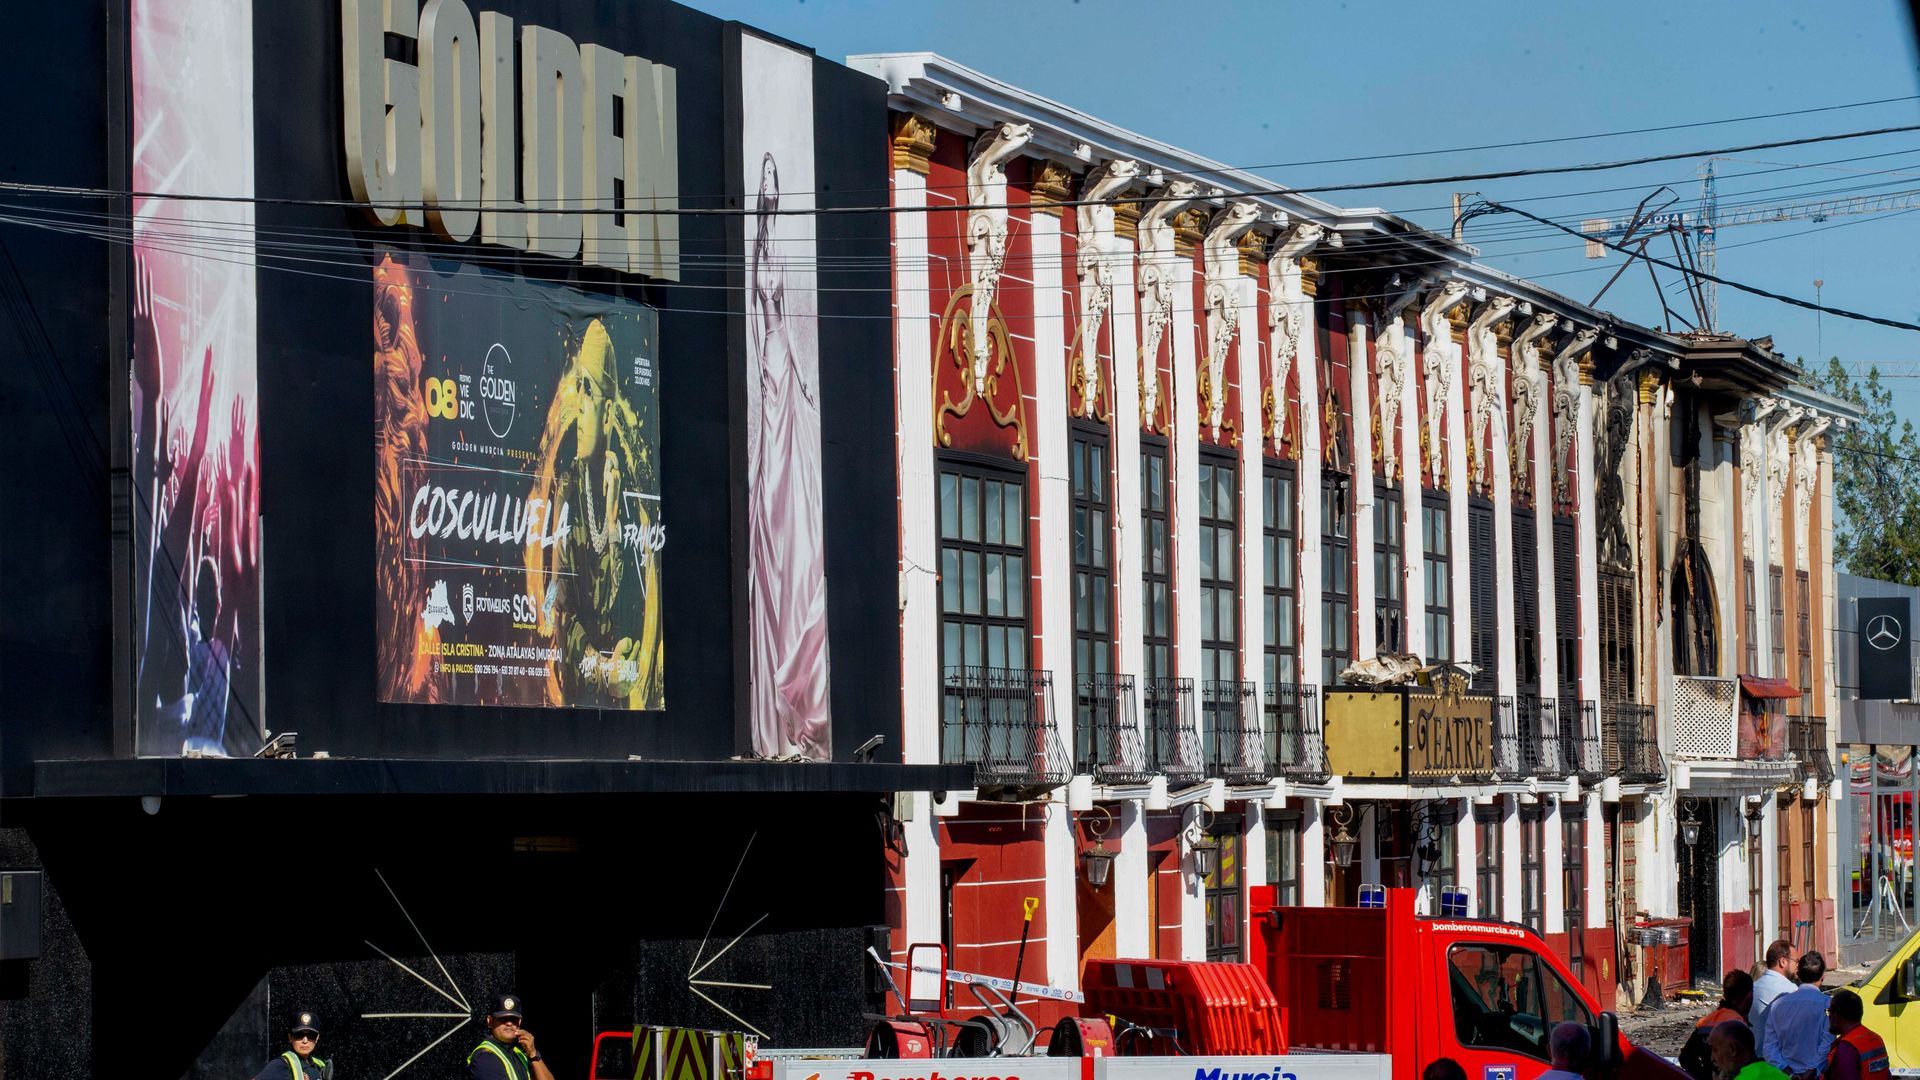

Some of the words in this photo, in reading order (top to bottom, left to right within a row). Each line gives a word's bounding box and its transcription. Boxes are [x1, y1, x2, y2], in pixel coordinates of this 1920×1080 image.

[342, 0, 680, 282] GOLDEN
[425, 377, 459, 420] 08
[460, 385, 470, 398] VIE
[480, 376, 515, 402] GOLDEN
[460, 400, 475, 420] DIC
[452, 441, 477, 453] GOLDEN
[480, 445, 504, 456] MURCIA
[410, 479, 571, 551] COSCULLUELA
[623, 522, 666, 552] FRANCIS
[513, 594, 537, 623] SCS
[420, 641, 440, 655] CALLE
[441, 643, 455, 656] ISLA
[456, 643, 484, 657] CRISTINA
[488, 645, 505, 658] ZONA
[506, 646, 535, 660] ATALAYAS
[536, 646, 563, 663] (MURCIA)
[440, 663, 451, 673] INFO
[1417, 703, 1485, 770] TEATRE
[1432, 922, 1525, 938] bomberosmurcia.org
